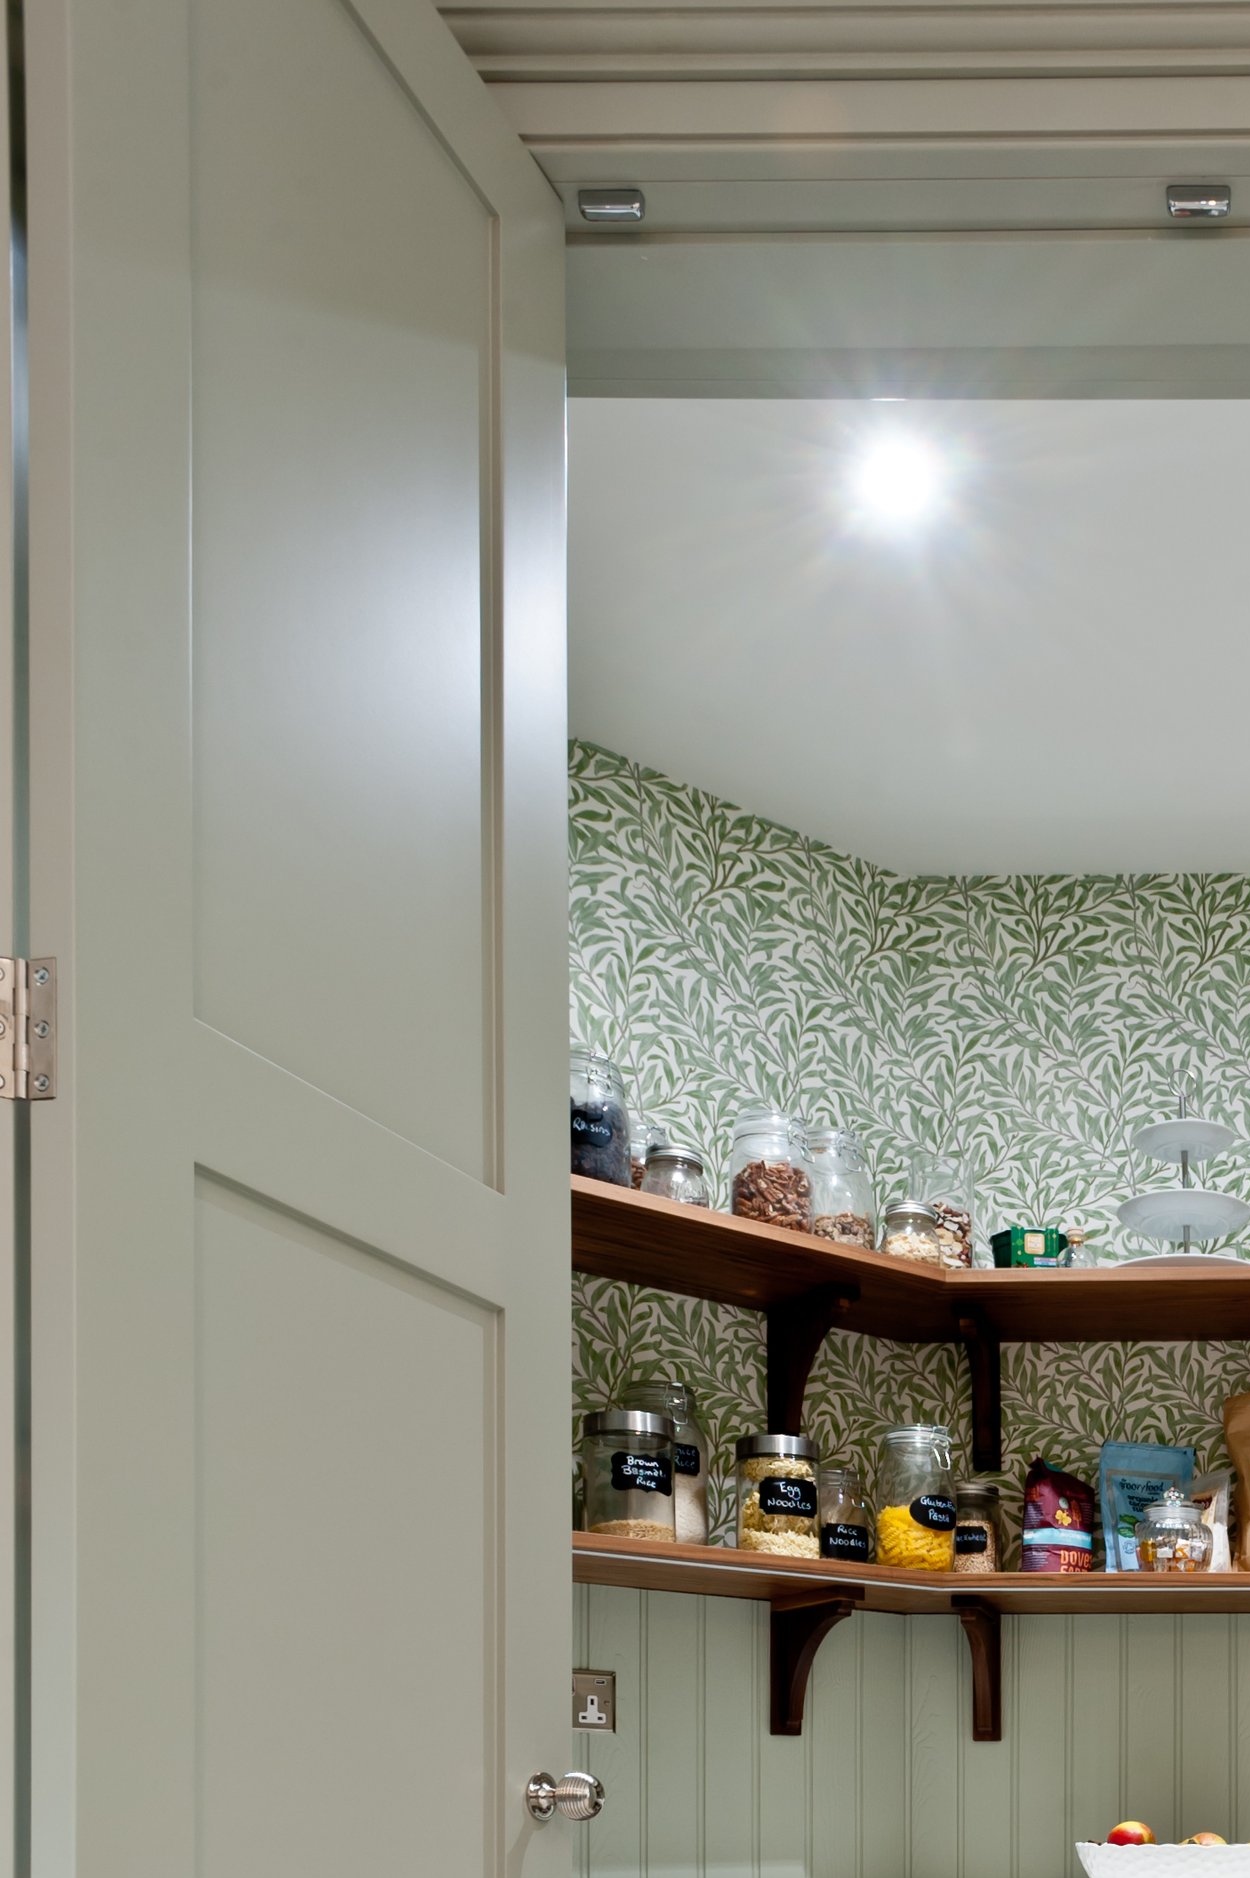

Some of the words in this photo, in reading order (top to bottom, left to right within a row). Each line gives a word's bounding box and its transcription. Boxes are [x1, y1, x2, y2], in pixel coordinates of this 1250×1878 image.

[626, 1455, 659, 1468] Brown
[636, 1476, 657, 1489] Rice
[780, 1481, 802, 1501] Egg
[928, 1508, 950, 1523] Pasta
[837, 1524, 858, 1536] Rice
[829, 1536, 866, 1549] Noodles
